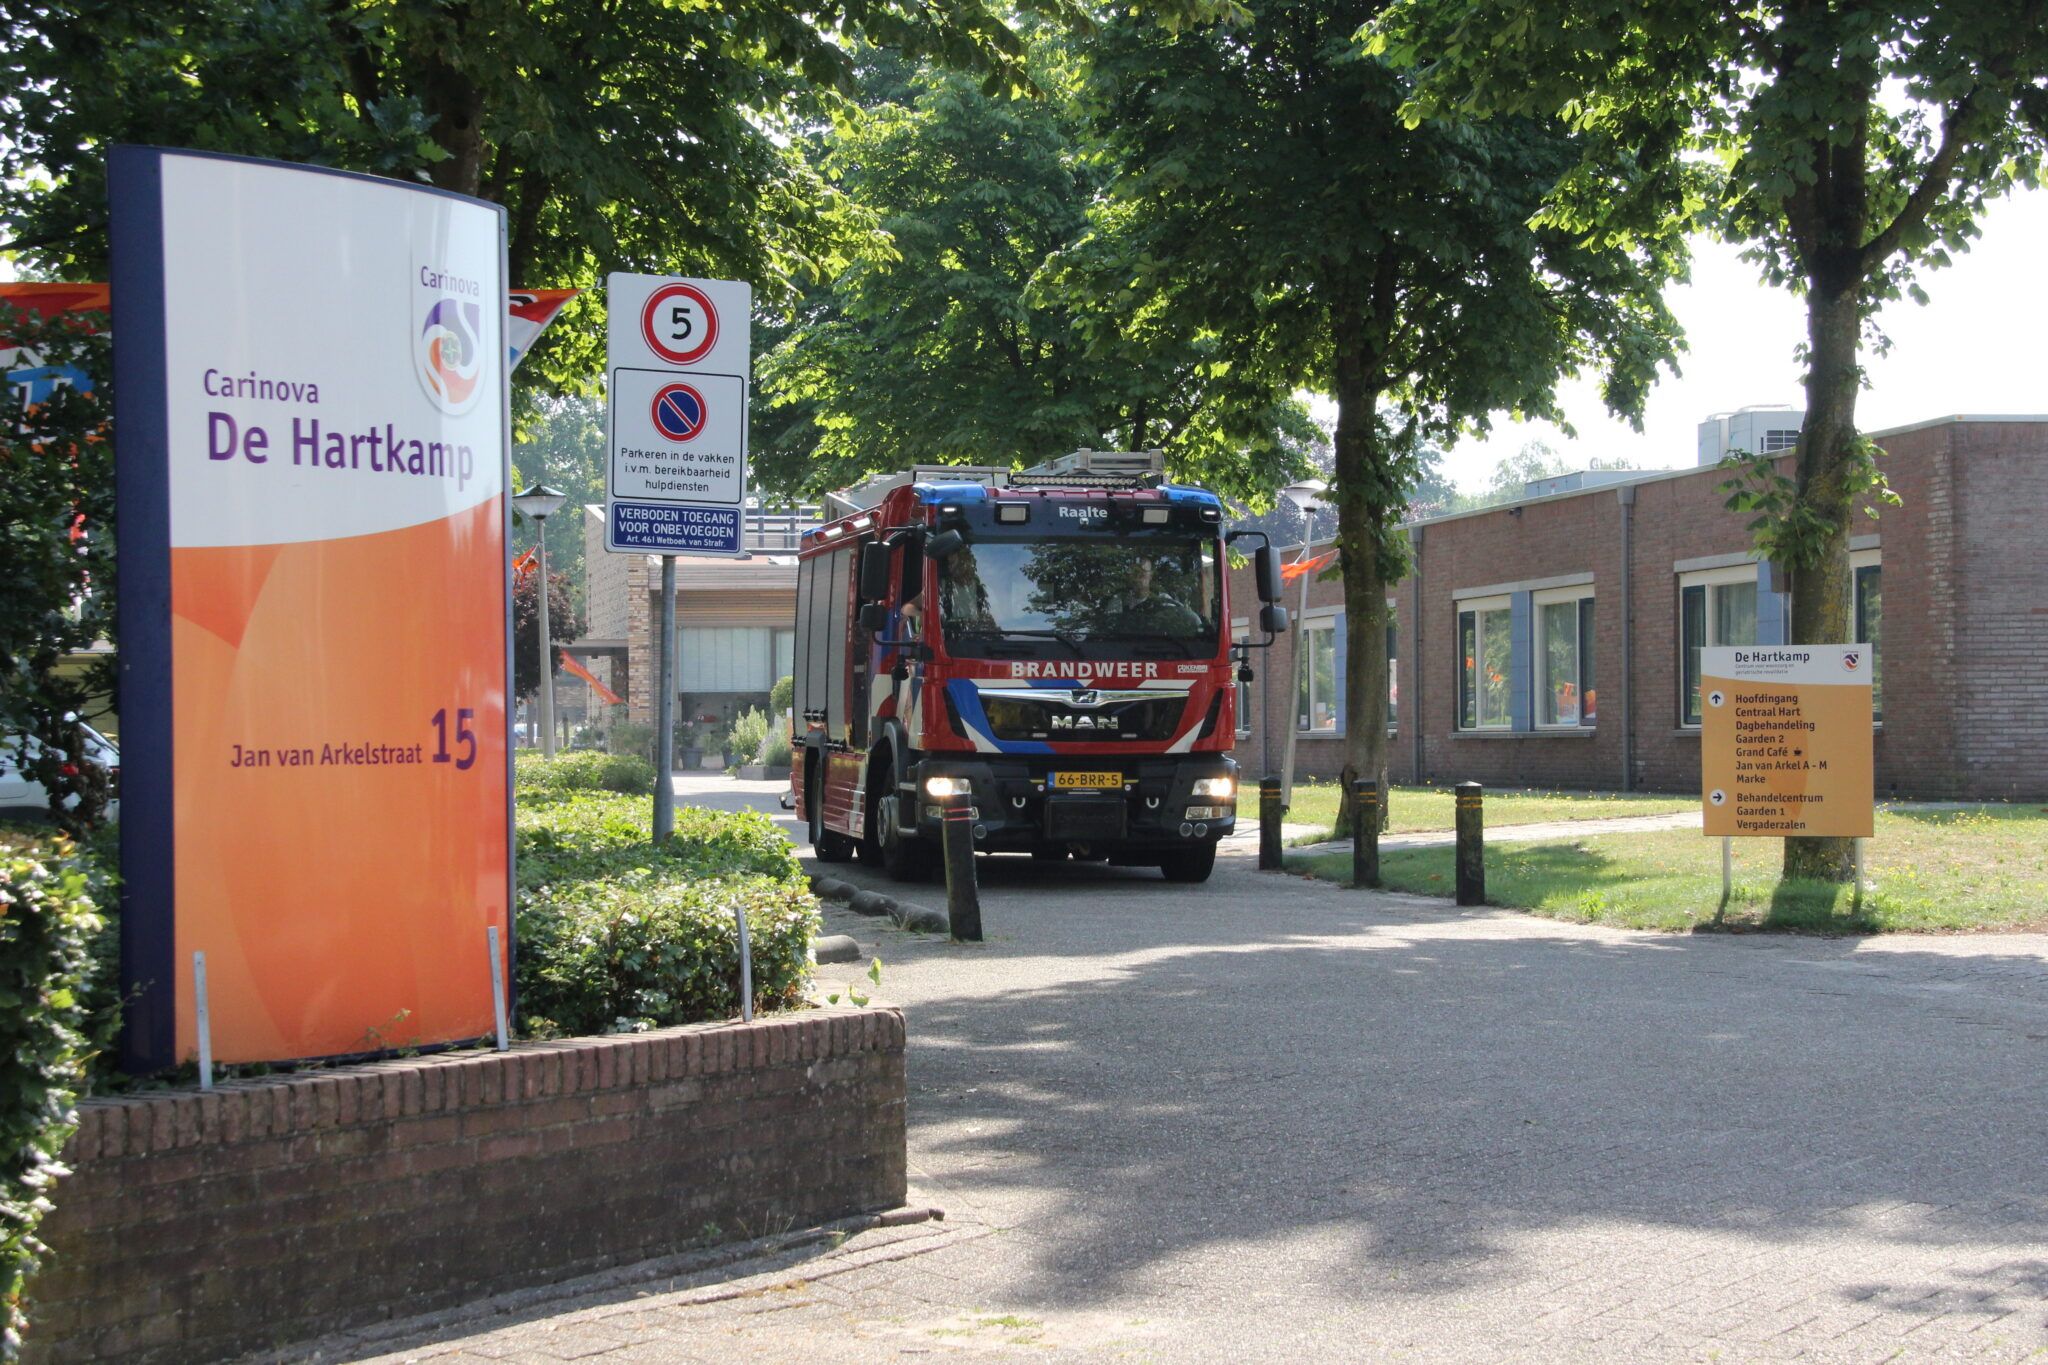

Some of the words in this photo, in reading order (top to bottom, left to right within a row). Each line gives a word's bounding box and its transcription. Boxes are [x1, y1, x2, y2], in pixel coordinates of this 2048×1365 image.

[420, 265, 480, 297] Carinova
[671, 307, 692, 340] 5
[203, 368, 319, 404] Carinova
[208, 411, 269, 464] De
[292, 416, 474, 492] Hartkamp
[621, 448, 667, 460] Parkeren
[670, 450, 680, 461] in
[682, 451, 695, 462] de
[698, 452, 735, 464] vakken
[624, 464, 651, 474] i.v.m.
[655, 465, 730, 479] bereikbaarheid
[645, 480, 709, 492] hulpdiensten
[618, 507, 679, 522] VERBODEN
[682, 511, 734, 525] TOEGANG
[1058, 505, 1108, 518] Raalte
[618, 521, 649, 534] VOOR
[652, 523, 734, 538] ONBEVOEGDEN
[626, 535, 640, 543] Art.
[641, 536, 655, 544] 461
[656, 536, 687, 545] Wetboek
[703, 539, 726, 548] Strafr.
[1735, 651, 1749, 663] De
[1752, 651, 1810, 664] Hartkamp
[1011, 662, 1158, 678] BRANDWEER
[1735, 693, 1799, 706] Hoofdingang
[1735, 707, 1777, 717] Centraal
[1778, 707, 1801, 717] Hart
[1051, 715, 1119, 730] MAN
[1735, 720, 1815, 732] Dagbehandeling
[230, 744, 271, 768] Jan
[277, 748, 315, 767] van
[320, 742, 422, 766] Arkelstraat
[431, 708, 477, 771] 15
[1735, 734, 1776, 744] Gaarden
[1778, 735, 1785, 744] 2
[1735, 747, 1765, 757] Grand
[1767, 747, 1788, 757] Café
[1735, 761, 1753, 770] Jan
[1755, 762, 1773, 770] van
[1774, 760, 1801, 770] Arkel
[1802, 760, 1810, 770] A
[1819, 760, 1828, 770] M
[1058, 774, 1119, 786] 66-BRR-5
[1736, 774, 1766, 784] Marke
[1736, 793, 1824, 803] Behandelcentrum
[1736, 806, 1777, 816] Gaarden
[1779, 807, 1785, 816] 1
[1736, 819, 1806, 831] Vergaderzalen
